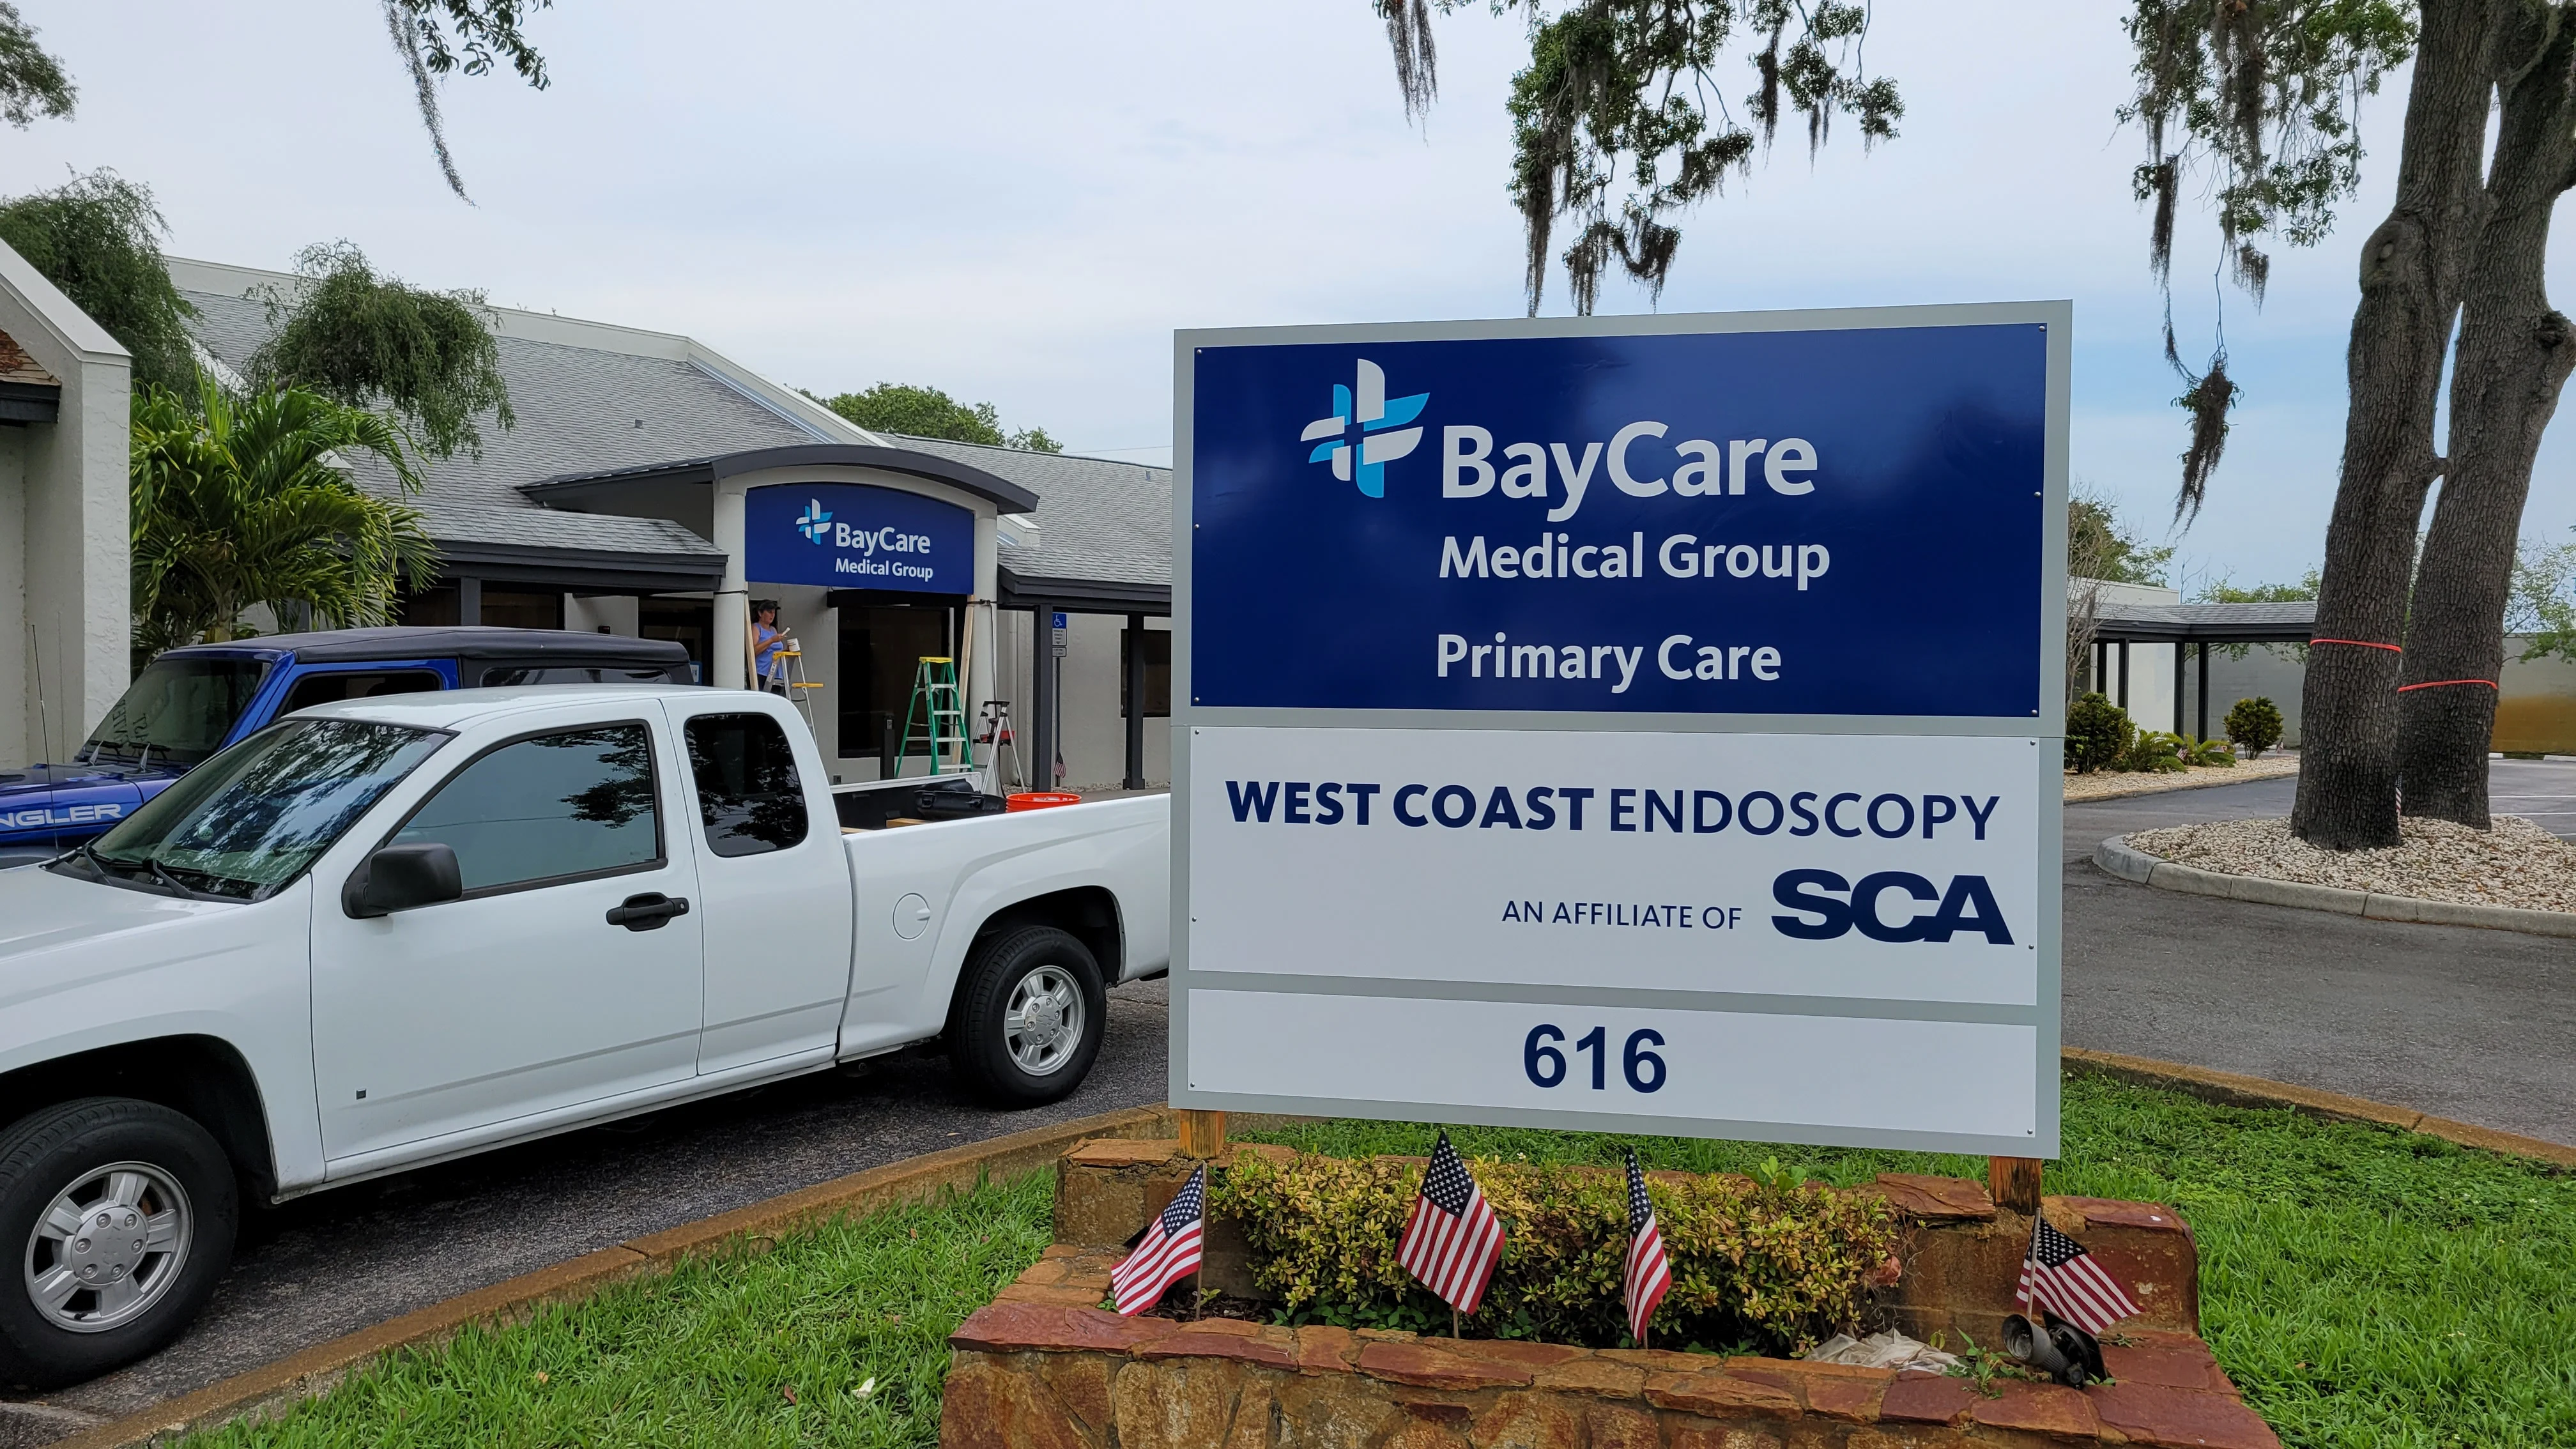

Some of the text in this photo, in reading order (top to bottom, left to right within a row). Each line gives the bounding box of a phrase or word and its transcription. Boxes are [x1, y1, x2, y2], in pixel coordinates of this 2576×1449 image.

[1443, 420, 1818, 523] BayCare
[835, 558, 933, 582] Medical Group
[836, 523, 931, 556] BayCare
[1439, 532, 1830, 591] Medical Group
[1438, 631, 1781, 694] Primary Care
[1225, 780, 2000, 841] WEST COAST ENDOSCOPY
[1501, 868, 2015, 946] AN AFFILIATE OF SCA
[1524, 1023, 1667, 1094] 616
